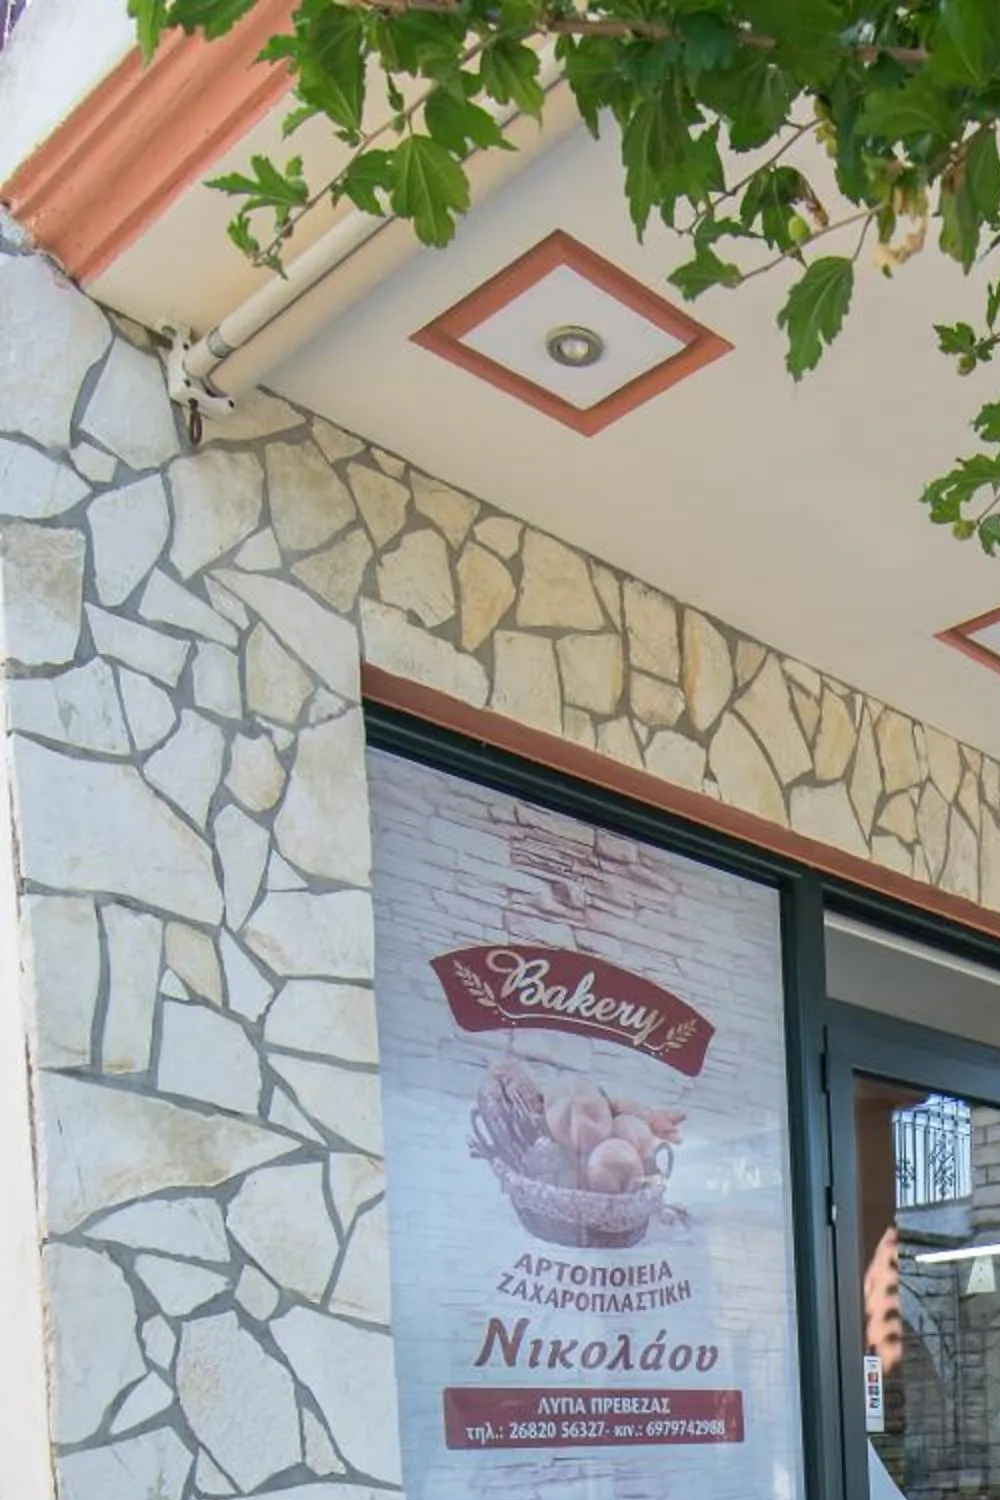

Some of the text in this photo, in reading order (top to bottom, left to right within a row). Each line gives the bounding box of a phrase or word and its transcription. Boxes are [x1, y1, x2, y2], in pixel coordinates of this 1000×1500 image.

[486, 949, 666, 1046] Bakery
[514, 1253, 673, 1287] ΑΡΤΟΠΟΙΕΙΑ
[496, 1272, 692, 1313] ΖΑΧΑΡΟΠΛΑΣΤΙΚΗ
[474, 1317, 719, 1373] Νικολάου
[591, 1397, 672, 1414] ΠΡΕΒΕΖΑΣ
[509, 1421, 557, 1439] 26820
